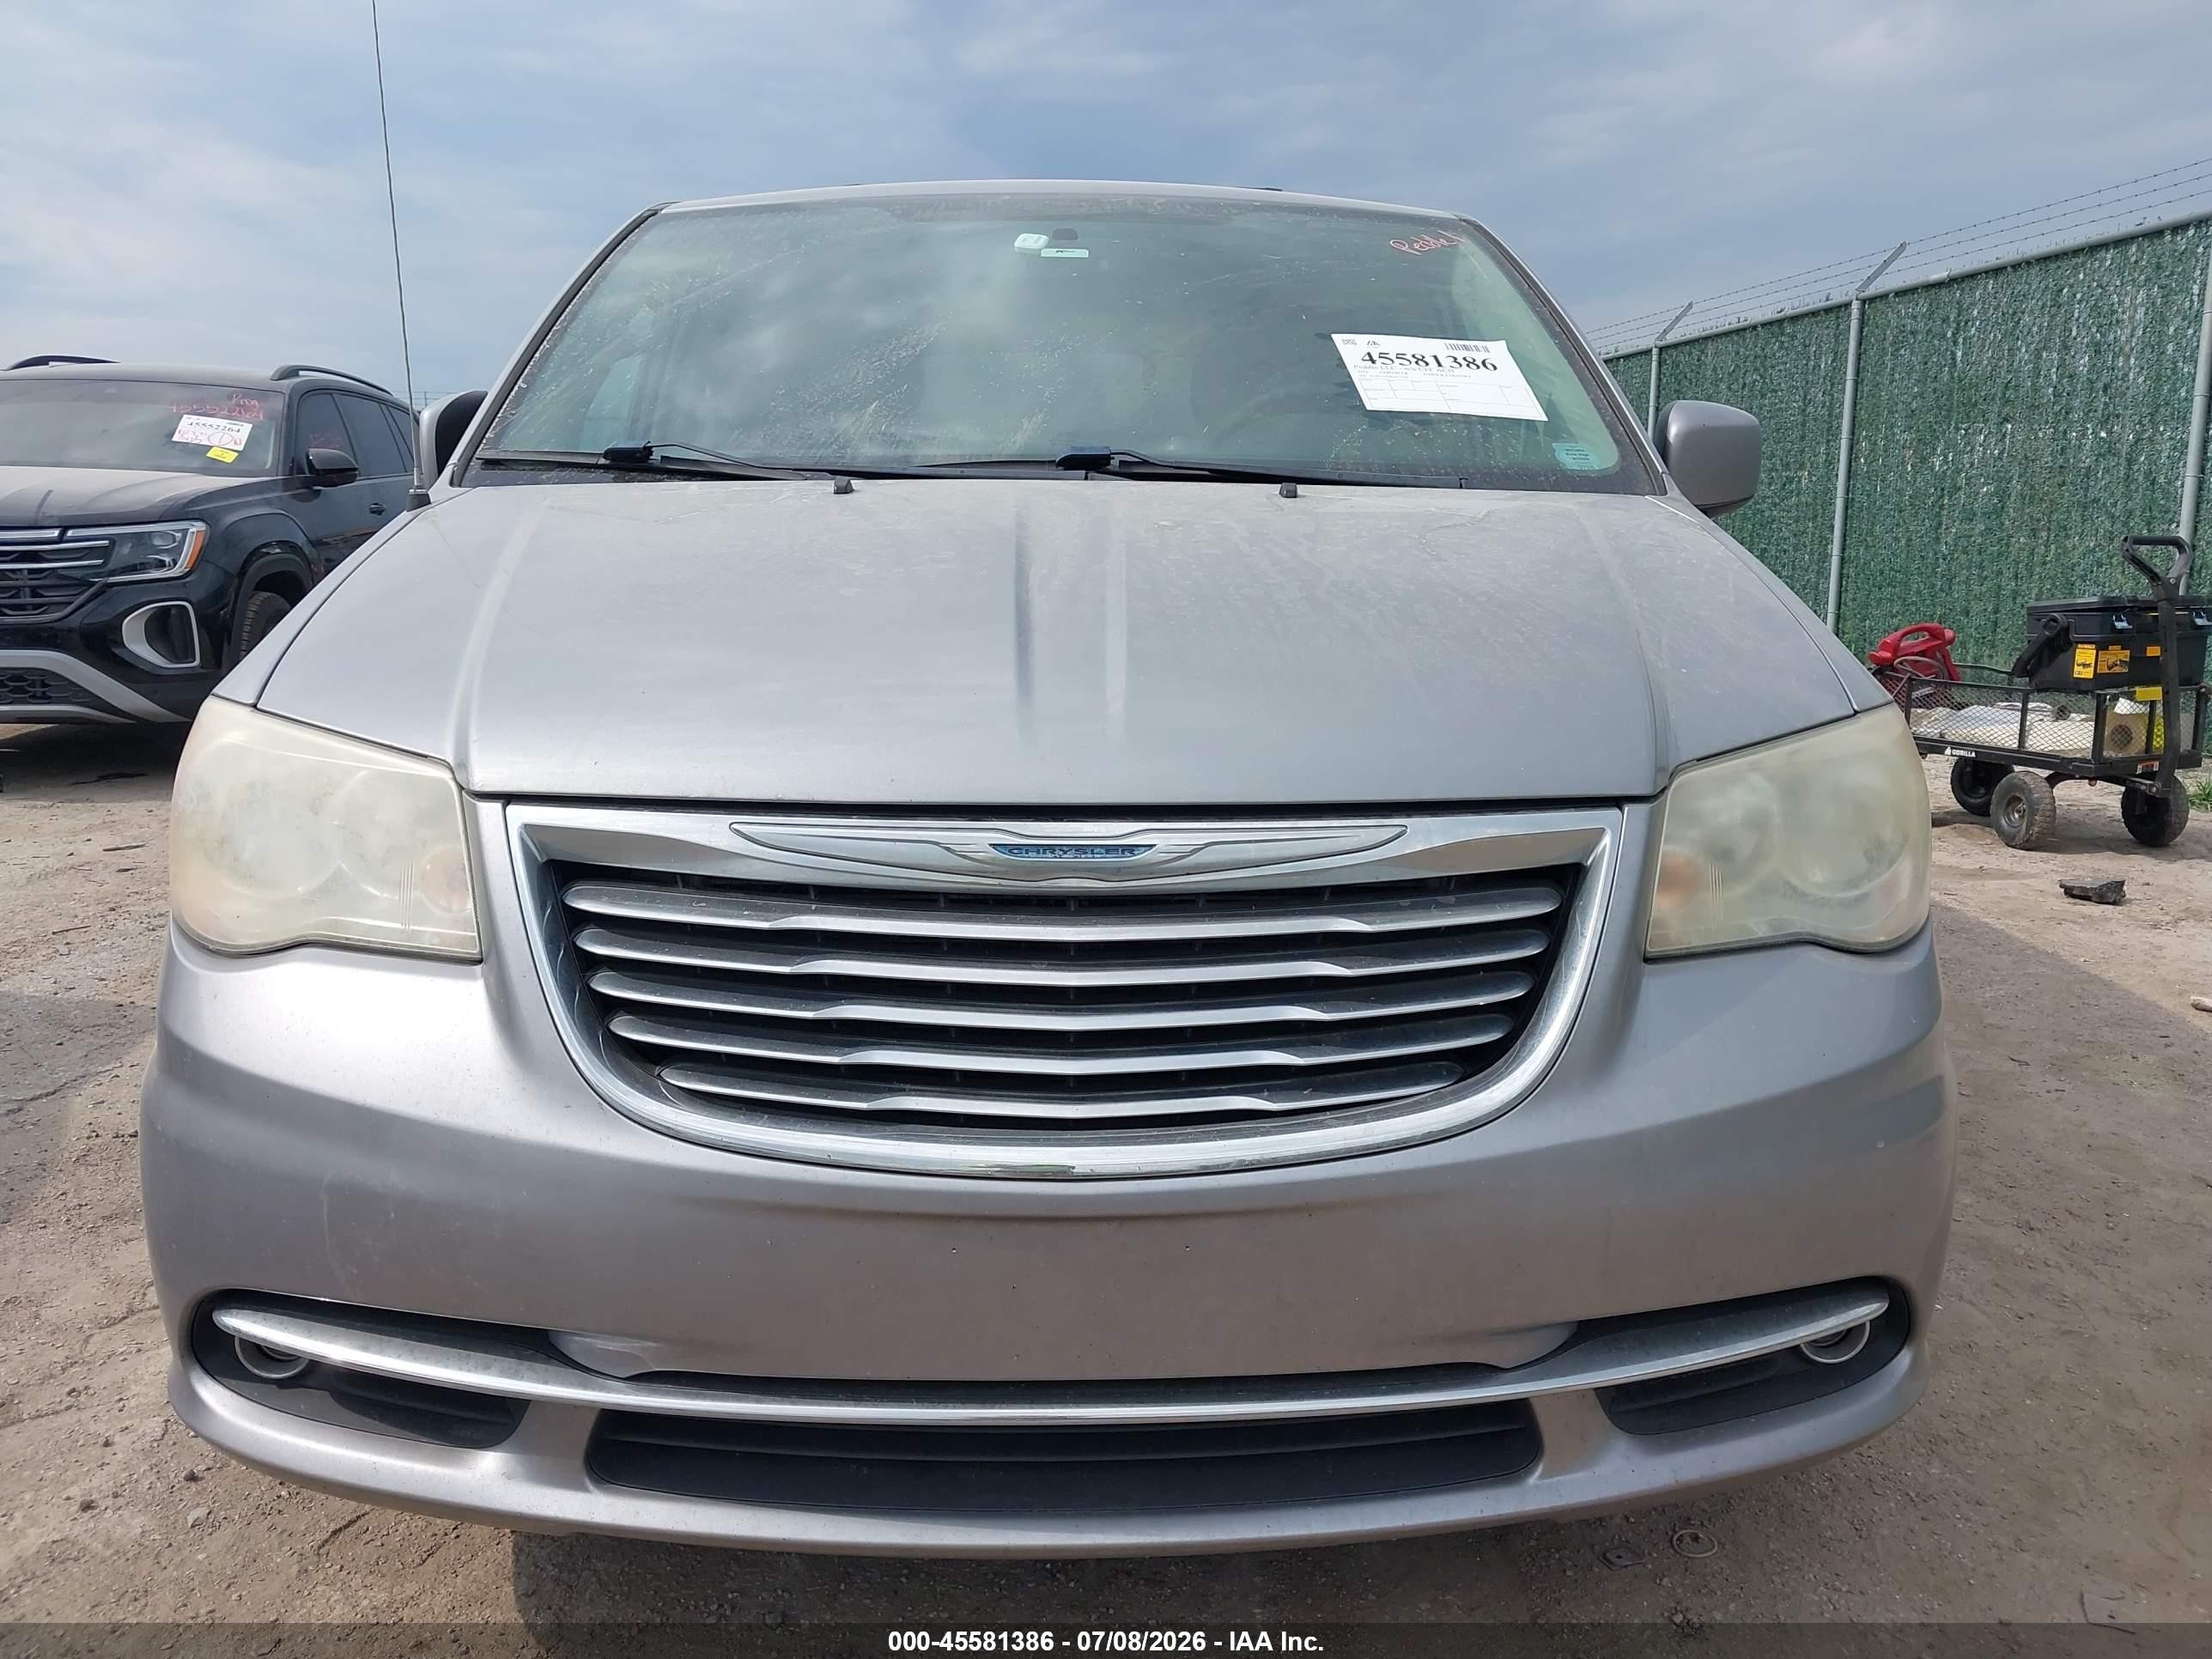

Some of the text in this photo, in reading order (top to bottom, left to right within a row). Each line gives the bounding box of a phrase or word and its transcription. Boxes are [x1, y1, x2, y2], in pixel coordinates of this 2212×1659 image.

[1361, 351, 1498, 372] 45581386
[186, 422, 241, 434] 45552264
[1952, 749, 1977, 758] GORILLA
[1007, 848, 1136, 856] CHRYSLER
